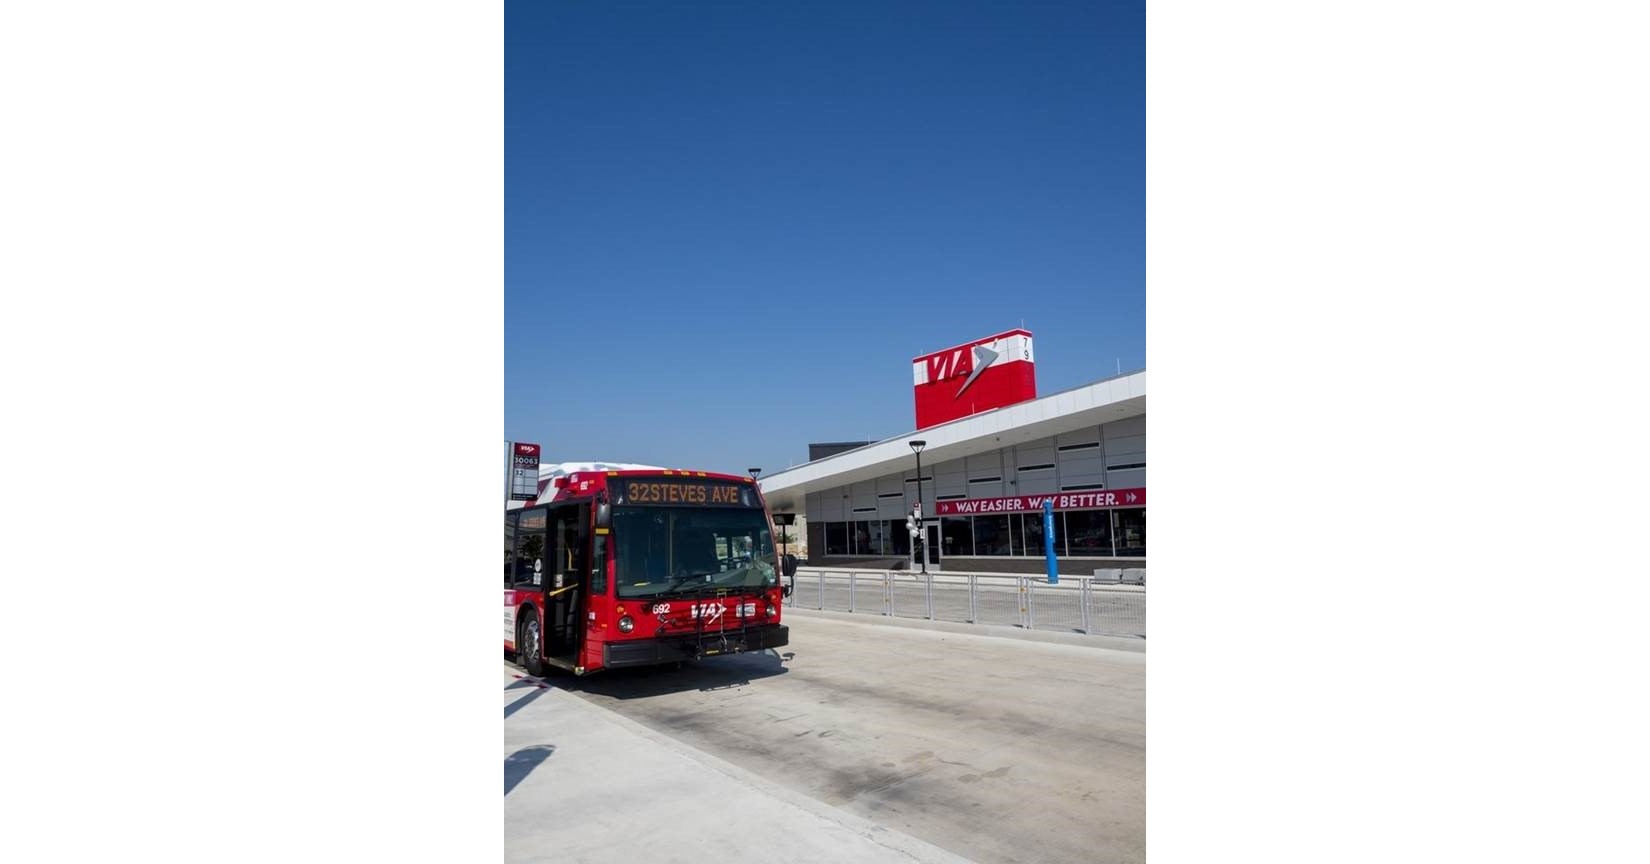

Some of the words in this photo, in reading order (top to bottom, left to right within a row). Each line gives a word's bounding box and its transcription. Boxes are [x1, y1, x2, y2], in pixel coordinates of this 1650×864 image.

[927, 346, 974, 385] VIA
[515, 457, 538, 465] 30063
[712, 486, 738, 503] AVE
[956, 501, 979, 513] WAY
[980, 499, 1025, 512] EASIER.
[1060, 493, 1119, 508] BETTER.
[652, 603, 671, 614] 692
[691, 603, 716, 618] VIA
